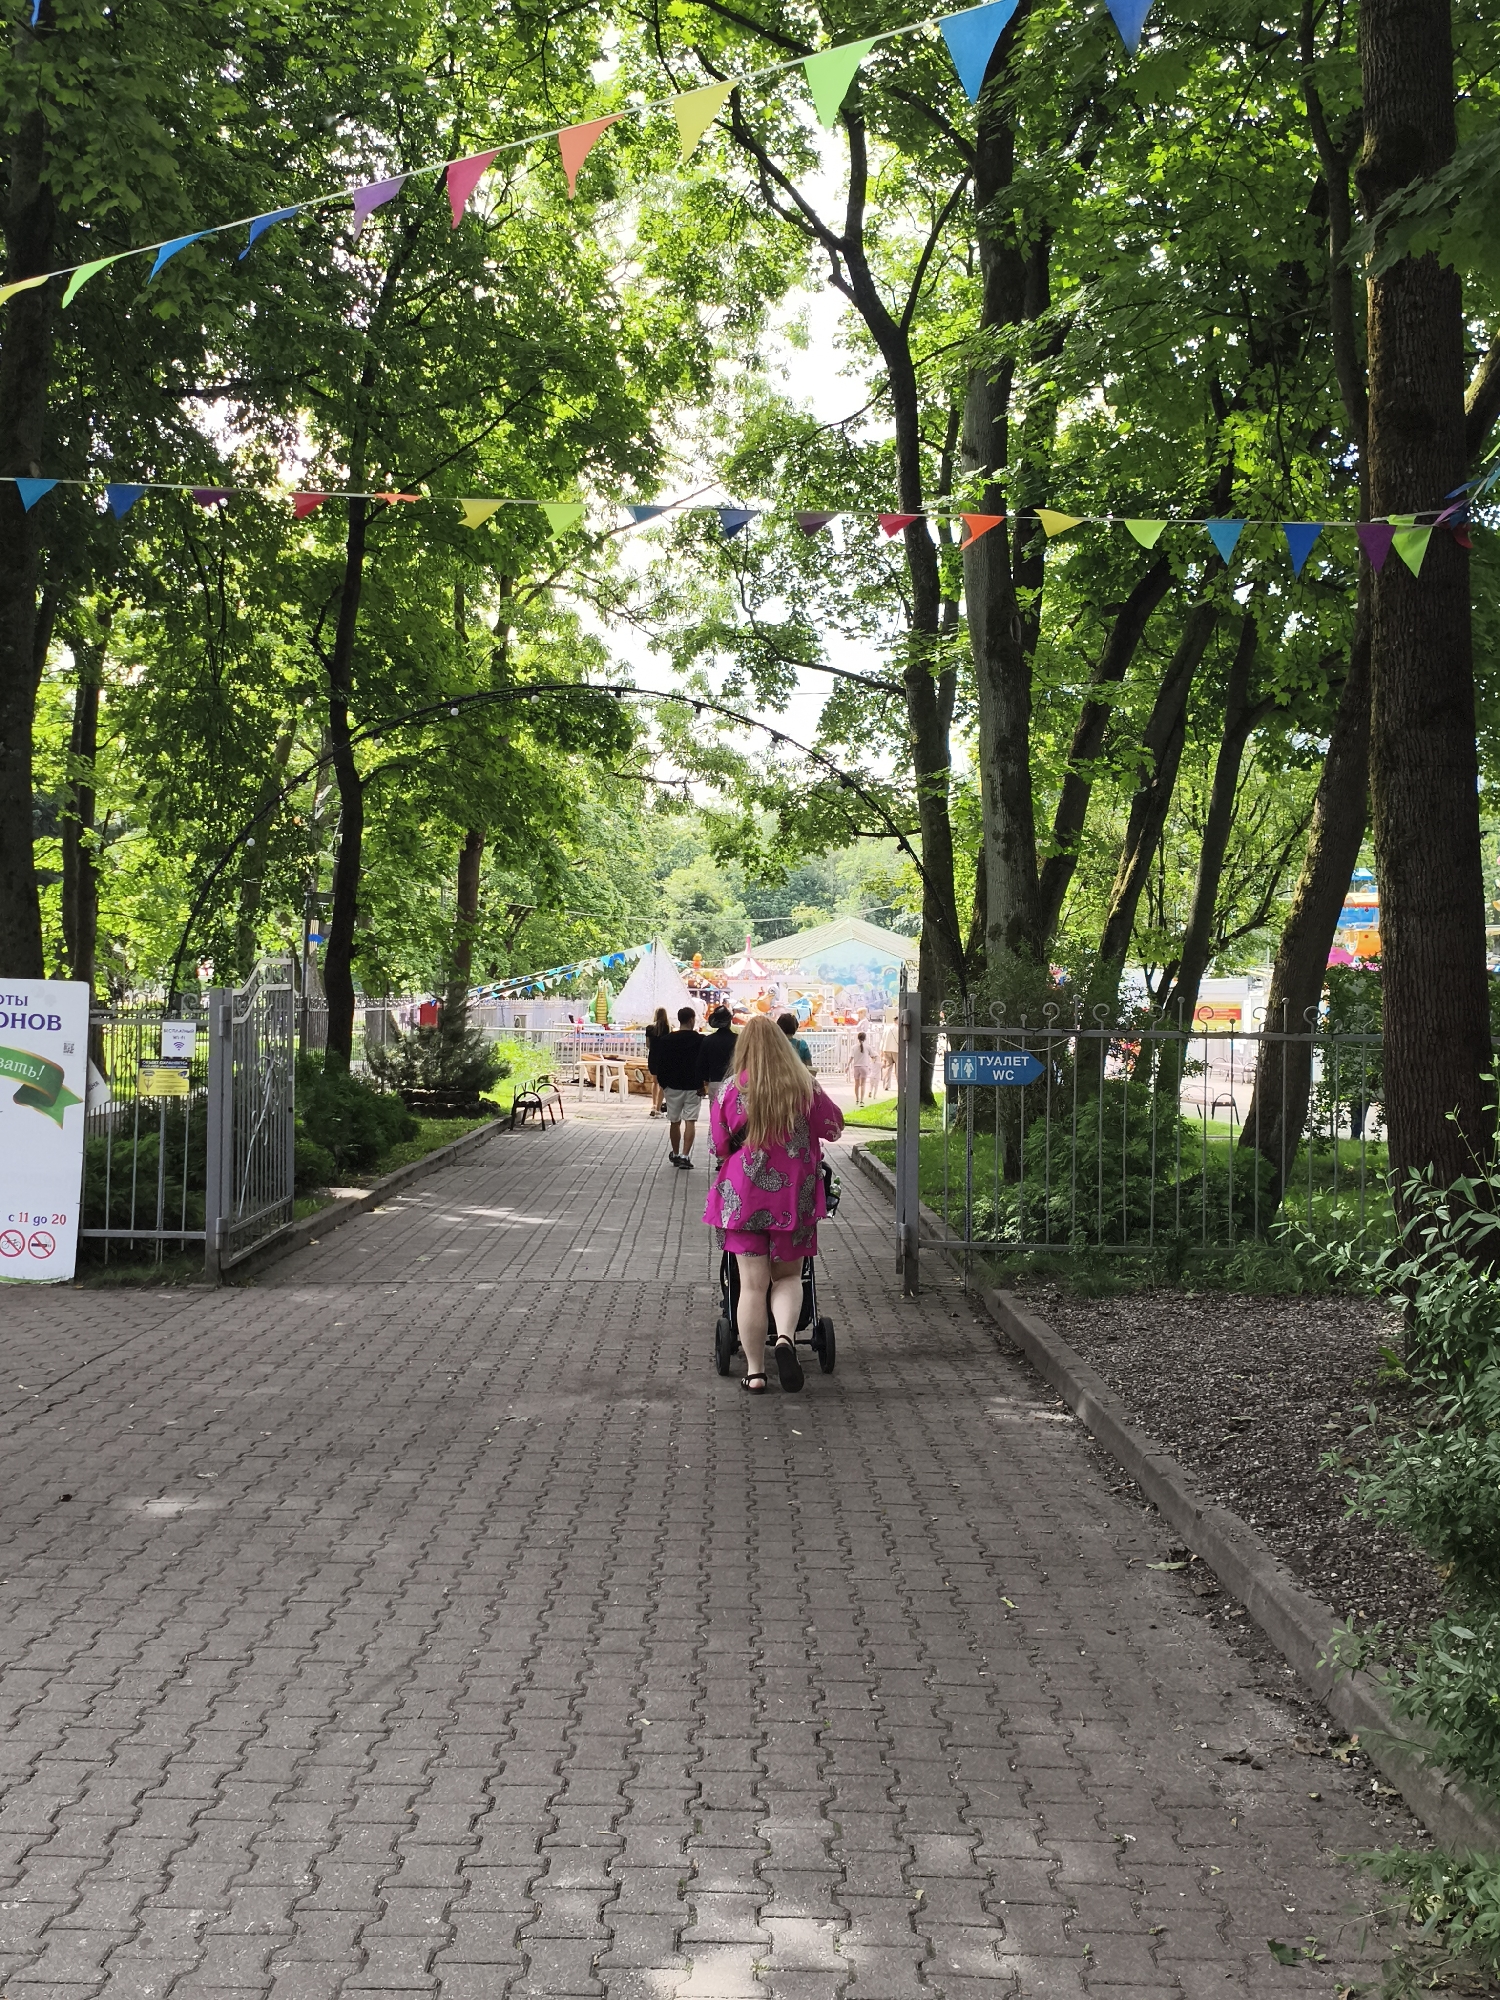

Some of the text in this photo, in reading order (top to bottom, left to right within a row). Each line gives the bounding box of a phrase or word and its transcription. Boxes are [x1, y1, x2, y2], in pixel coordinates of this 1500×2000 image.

[978, 1056, 1030, 1066] ТУАЛЕТ
[992, 1070, 1015, 1081] WC
[18, 1211, 29, 1223] 11
[51, 1213, 67, 1225] 20
